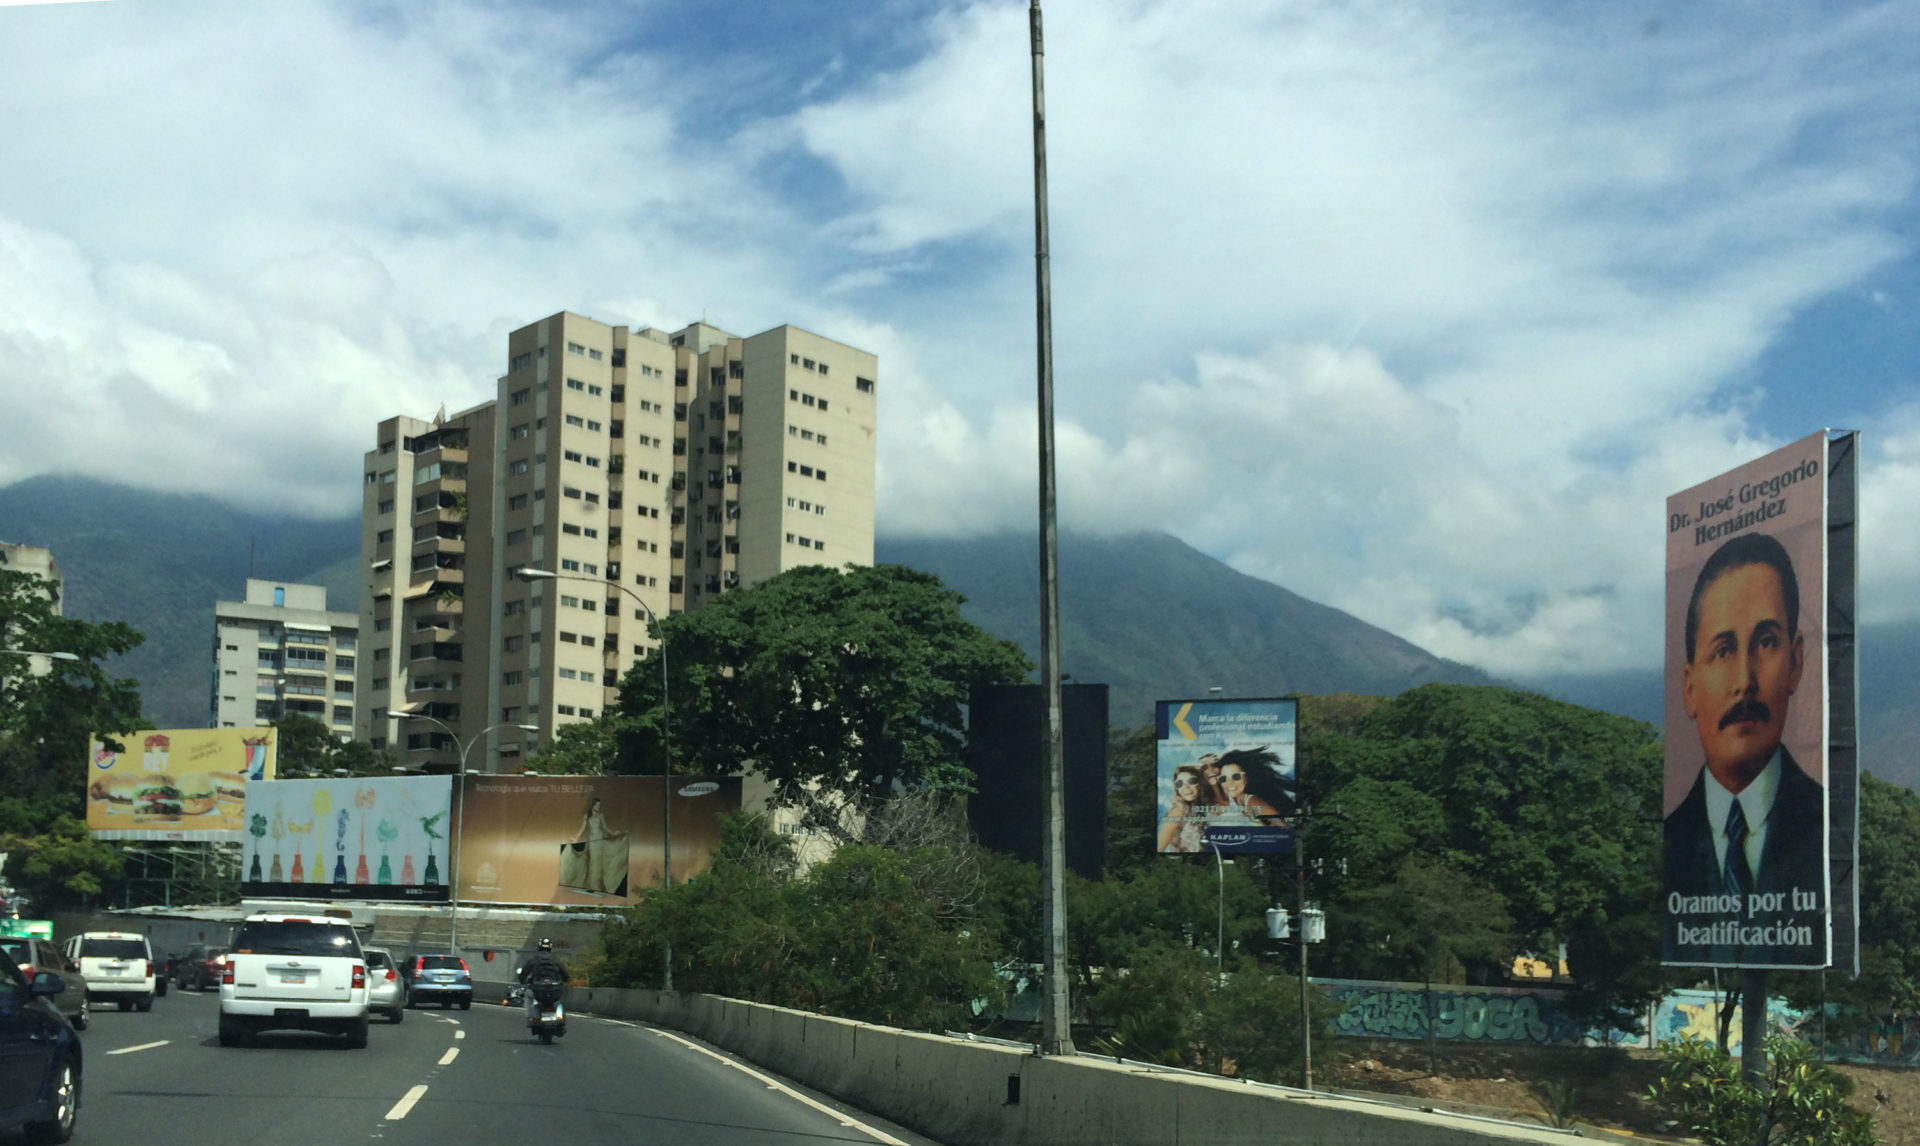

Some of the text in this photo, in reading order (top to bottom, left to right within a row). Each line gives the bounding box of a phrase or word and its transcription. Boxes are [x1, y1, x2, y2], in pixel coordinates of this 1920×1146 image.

[1669, 460, 1819, 533] Dr. José Gregorio
[1694, 498, 1786, 546] Hernández
[1199, 714, 1225, 722] Marca
[1668, 886, 1817, 919] Oramos por tu
[1677, 918, 1813, 946] beatificación
